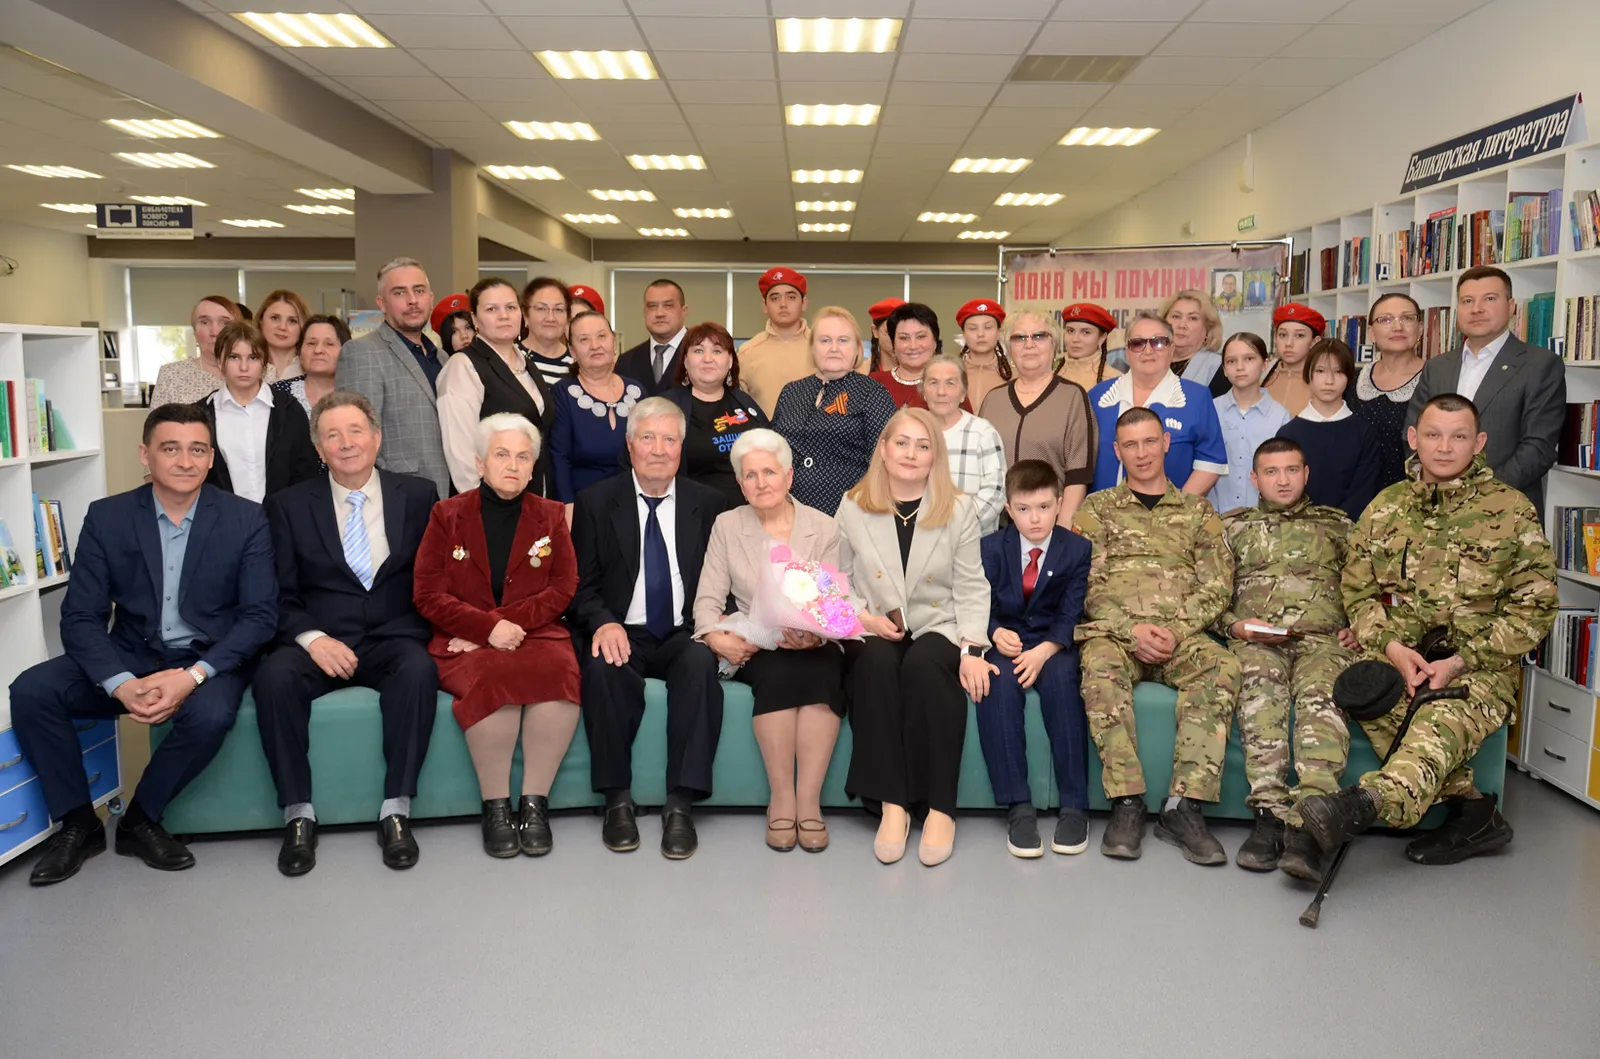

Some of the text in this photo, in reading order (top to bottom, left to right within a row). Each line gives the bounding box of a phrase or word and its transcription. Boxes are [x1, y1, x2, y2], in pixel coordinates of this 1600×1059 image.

[1404, 108, 1570, 184] Башкирская литература
[1379, 264, 1389, 280] Д
[1014, 268, 1207, 300] ПОКА МЫ ПОМНИМ
[712, 432, 743, 445] ЗАЩИ
[718, 443, 734, 453] ОТ
